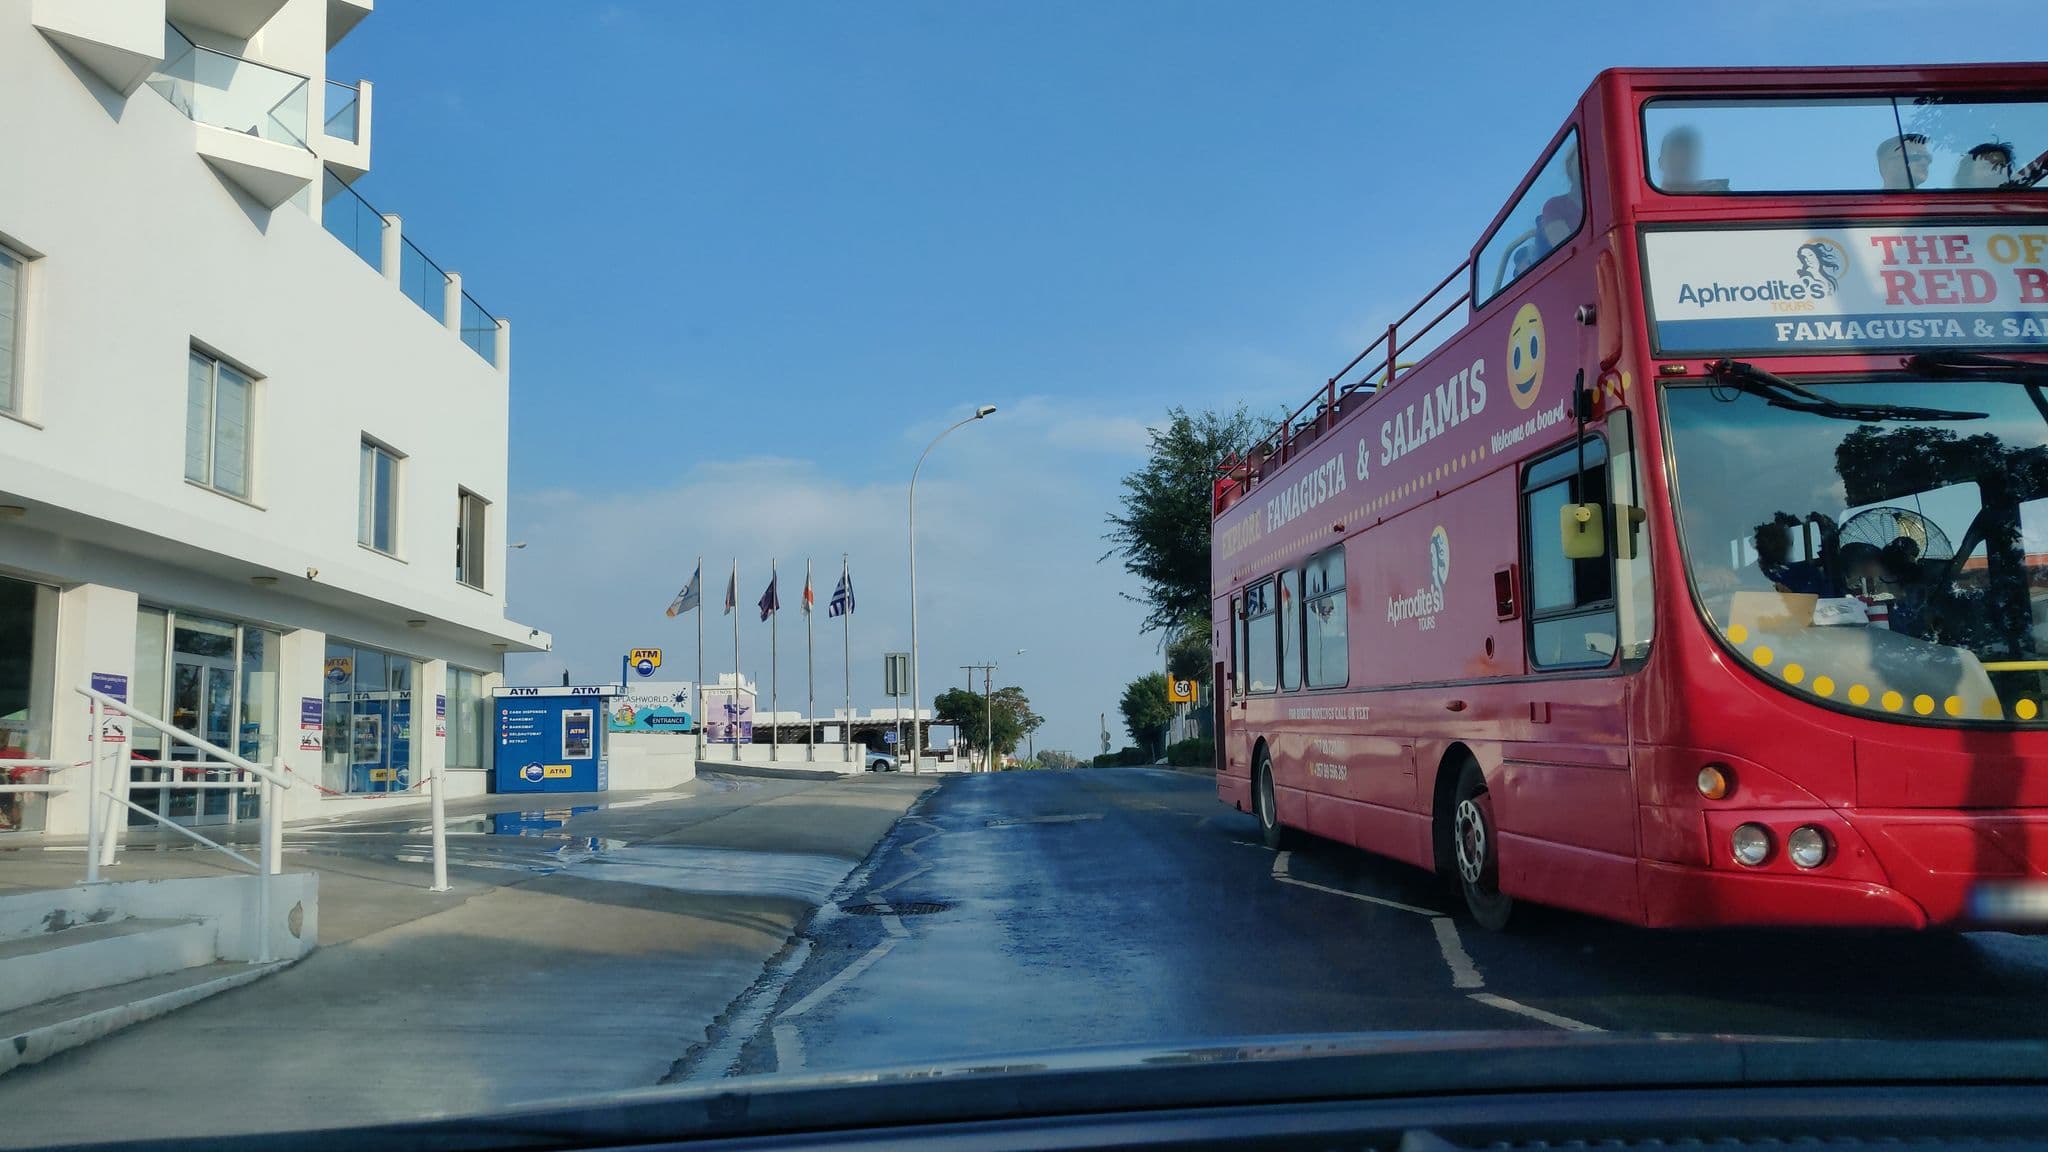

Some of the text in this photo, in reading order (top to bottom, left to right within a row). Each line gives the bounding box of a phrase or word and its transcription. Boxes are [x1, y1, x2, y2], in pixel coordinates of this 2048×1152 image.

[1871, 234, 1974, 265] THE
[1678, 278, 1826, 308] Aphrodite's
[1881, 267, 1998, 305] RED
[1770, 300, 1816, 312] TOURS
[1775, 318, 1967, 343] FAMAGUSTA
[1973, 318, 1995, 339] &
[1491, 398, 1565, 455] Welcome on board
[1266, 452, 1347, 534] FAMAGUSTA
[1357, 438, 1370, 481] &
[1381, 358, 1488, 467] SALAMIS
[1387, 584, 1440, 628] Aphrodite's
[1418, 615, 1436, 631] TOURS
[634, 650, 658, 659] ATM
[509, 687, 601, 696] ATM ATM
[1177, 682, 1190, 693] 50
[612, 695, 669, 704] SPLASHWORLD
[652, 716, 684, 724] ENTRANCE
